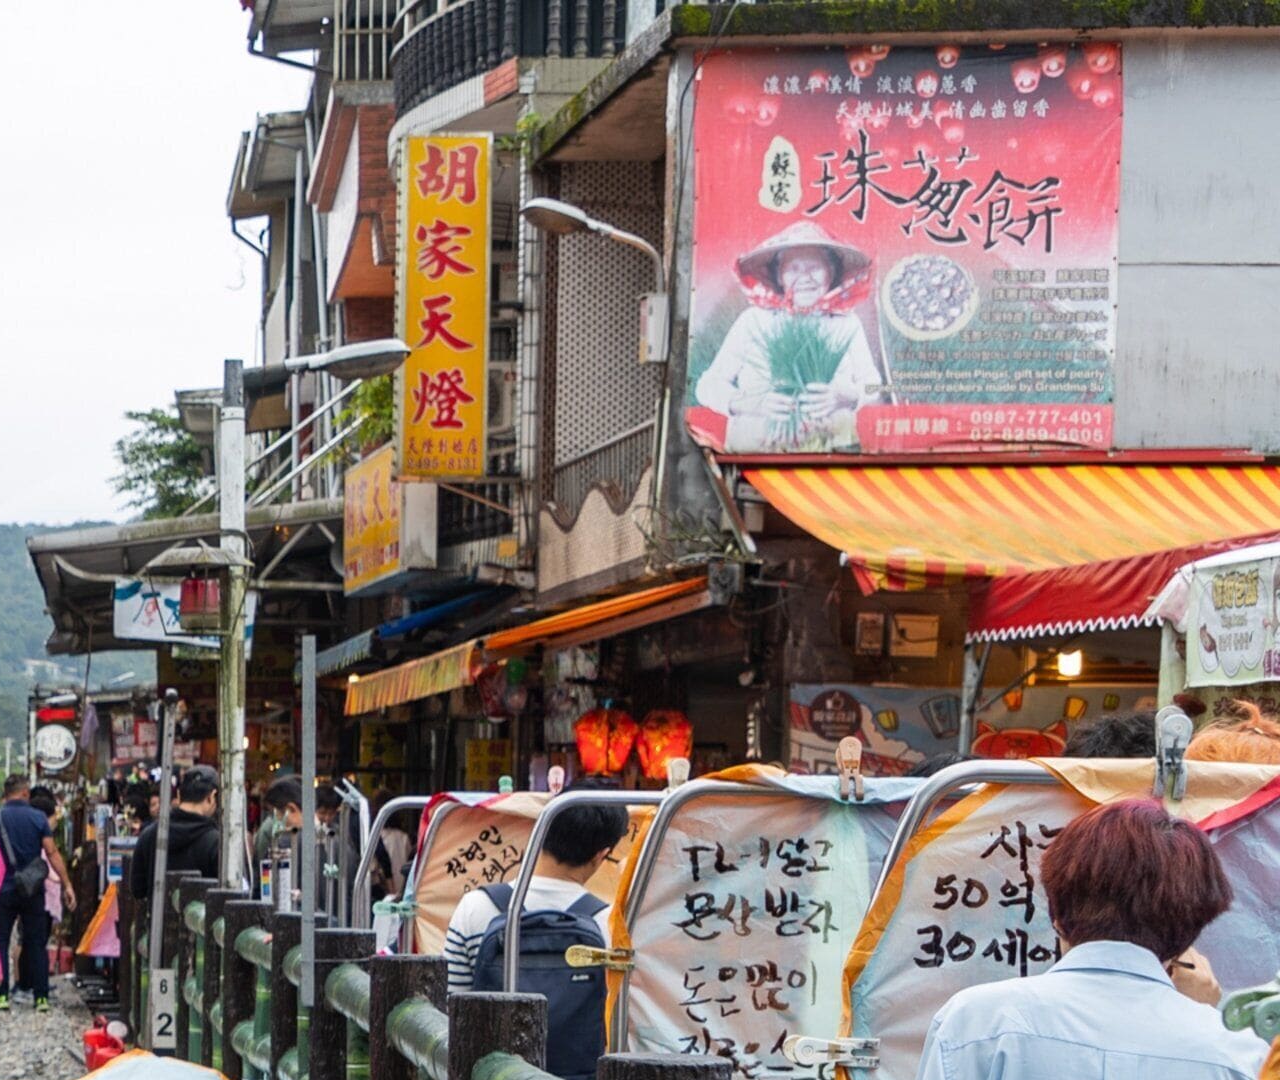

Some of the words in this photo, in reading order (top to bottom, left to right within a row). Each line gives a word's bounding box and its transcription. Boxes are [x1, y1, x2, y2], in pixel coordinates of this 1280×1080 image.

[412, 144, 479, 430] 胡家天燈
[159, 978, 168, 995] 6
[156, 1012, 173, 1037] 2
